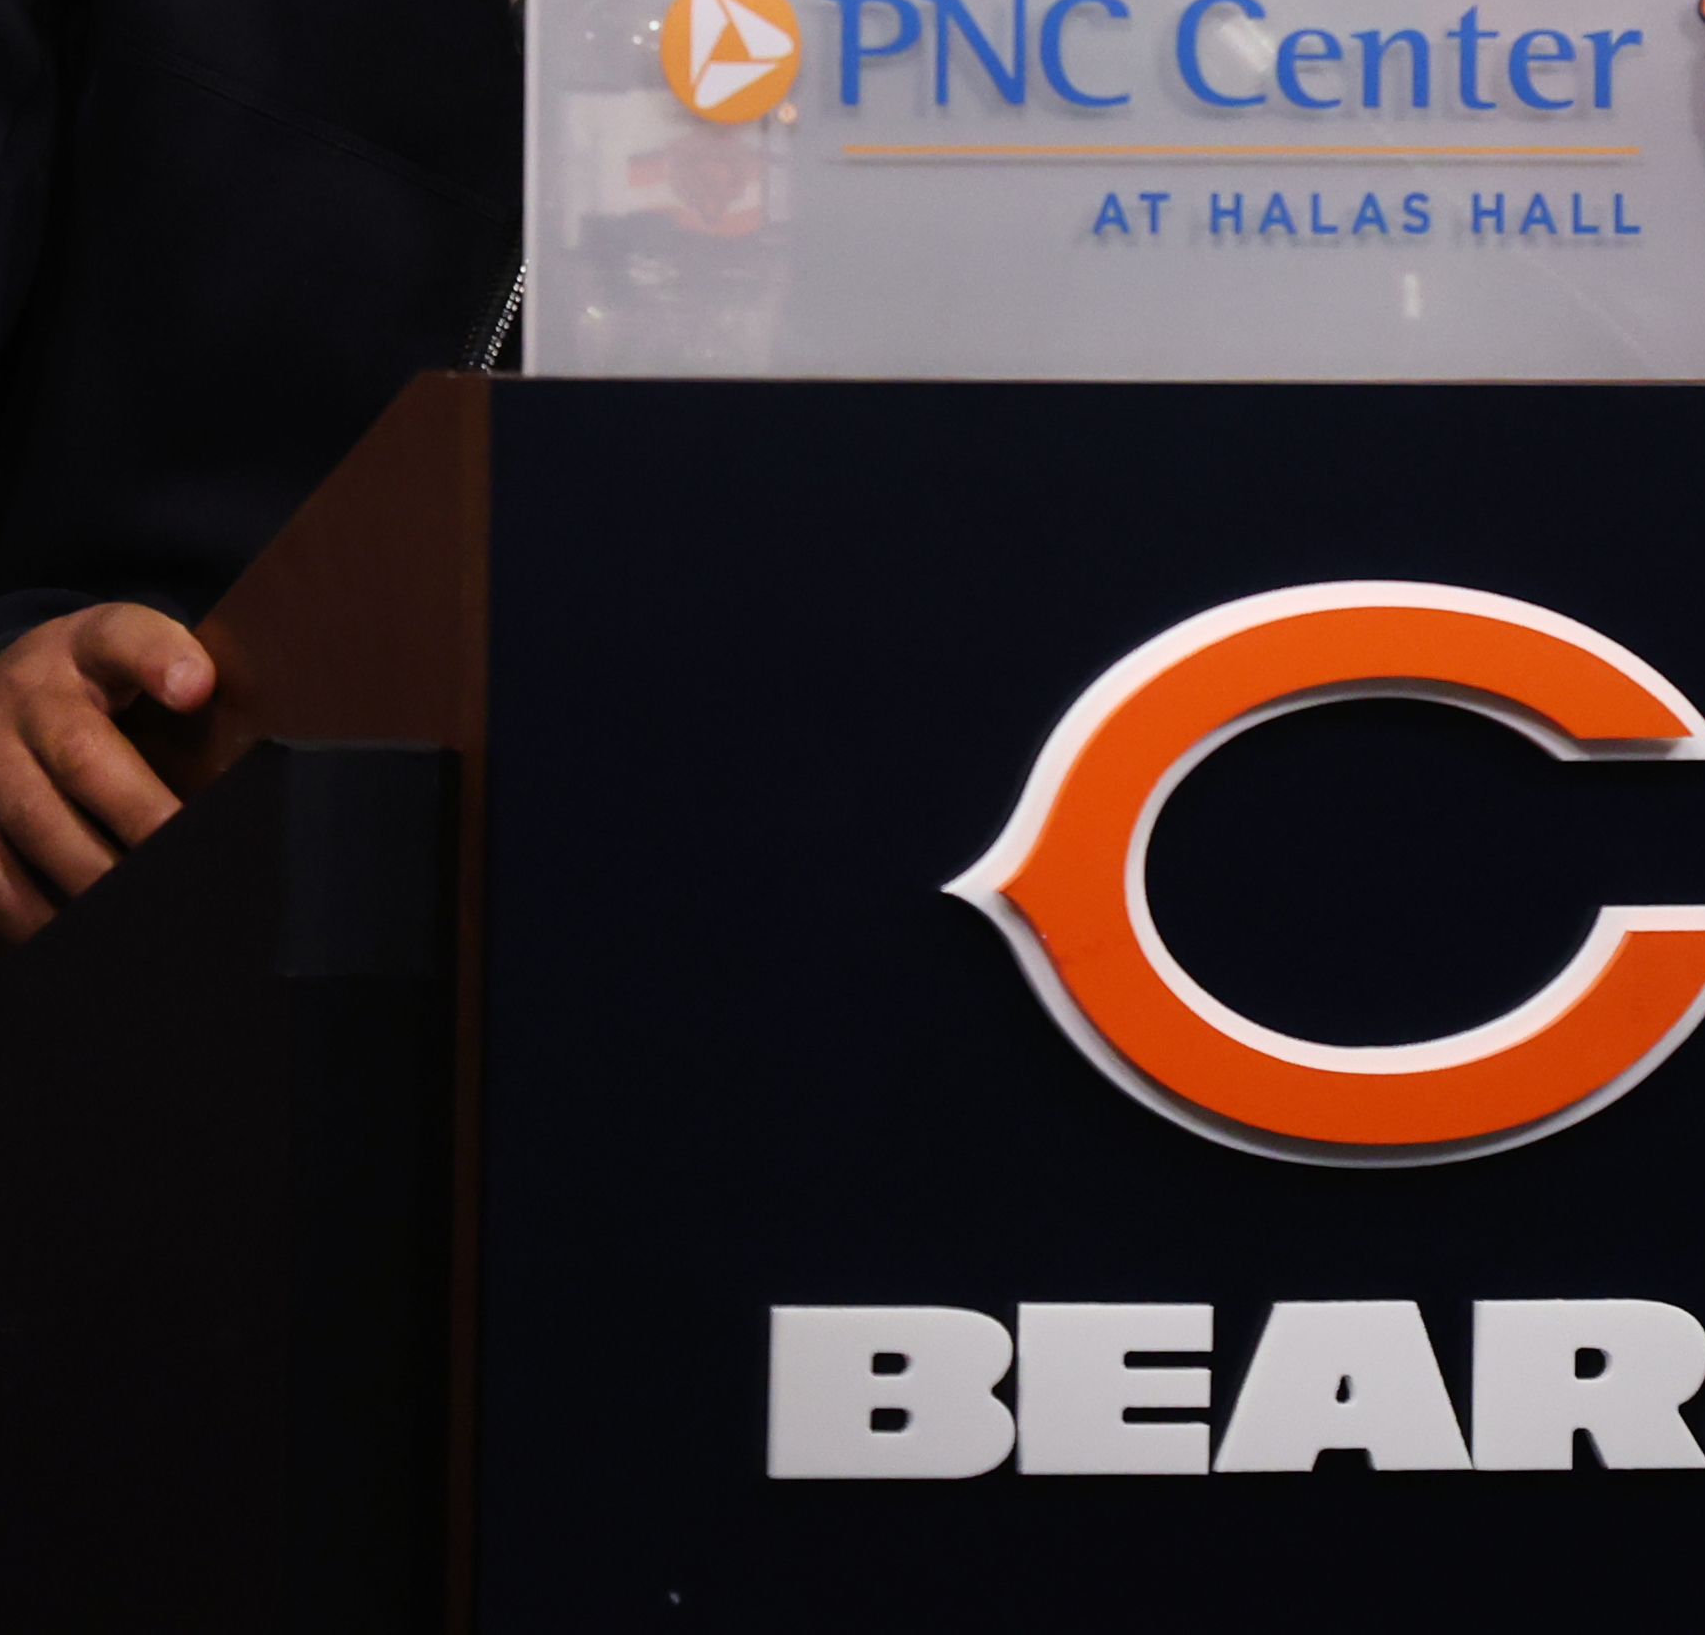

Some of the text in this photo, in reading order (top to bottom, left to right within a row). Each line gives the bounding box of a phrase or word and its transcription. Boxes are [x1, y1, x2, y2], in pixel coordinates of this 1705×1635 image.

[1093, 191, 1642, 235] AT HALAS HALL
